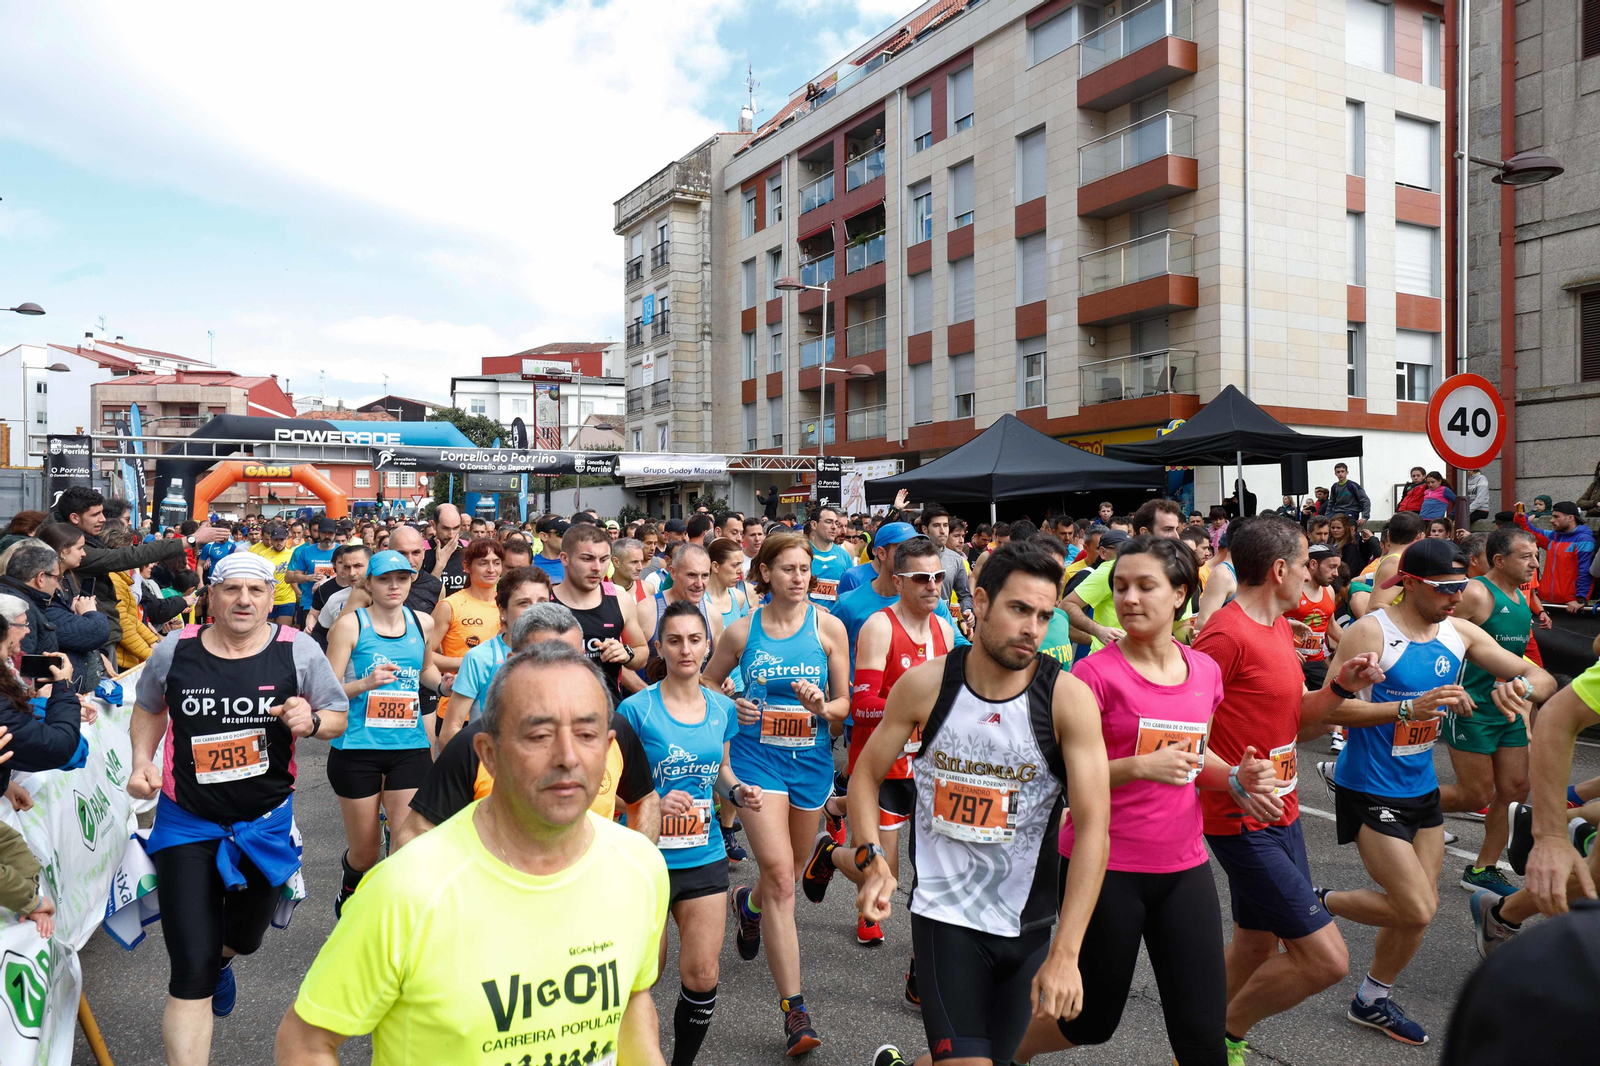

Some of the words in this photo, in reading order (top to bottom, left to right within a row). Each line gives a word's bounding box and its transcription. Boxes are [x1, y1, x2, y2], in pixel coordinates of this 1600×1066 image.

[644, 301, 652, 318] 19
[1446, 406, 1491, 438] 40
[275, 428, 400, 445] POWERADE
[440, 450, 490, 462] Concello
[493, 452, 508, 462] do
[510, 452, 556, 464] Porriño
[244, 466, 291, 477] GADIS
[643, 466, 666, 475] Grupo
[668, 467, 692, 475] Godoy
[751, 662, 820, 678] castrelos
[182, 688, 215, 696] oporriño
[378, 702, 406, 718] 383
[866, 708, 885, 718] balan
[773, 718, 803, 736] 1001
[1408, 726, 1431, 744] 917
[208, 746, 247, 771] 293
[934, 750, 1037, 782] SILICMAG
[946, 774, 968, 783] CARREIRA
[953, 785, 990, 796] ALEJANDRO
[949, 792, 993, 826] 797
[482, 1028, 556, 1053] CARREIRA
[561, 1012, 621, 1037] POPULAR
